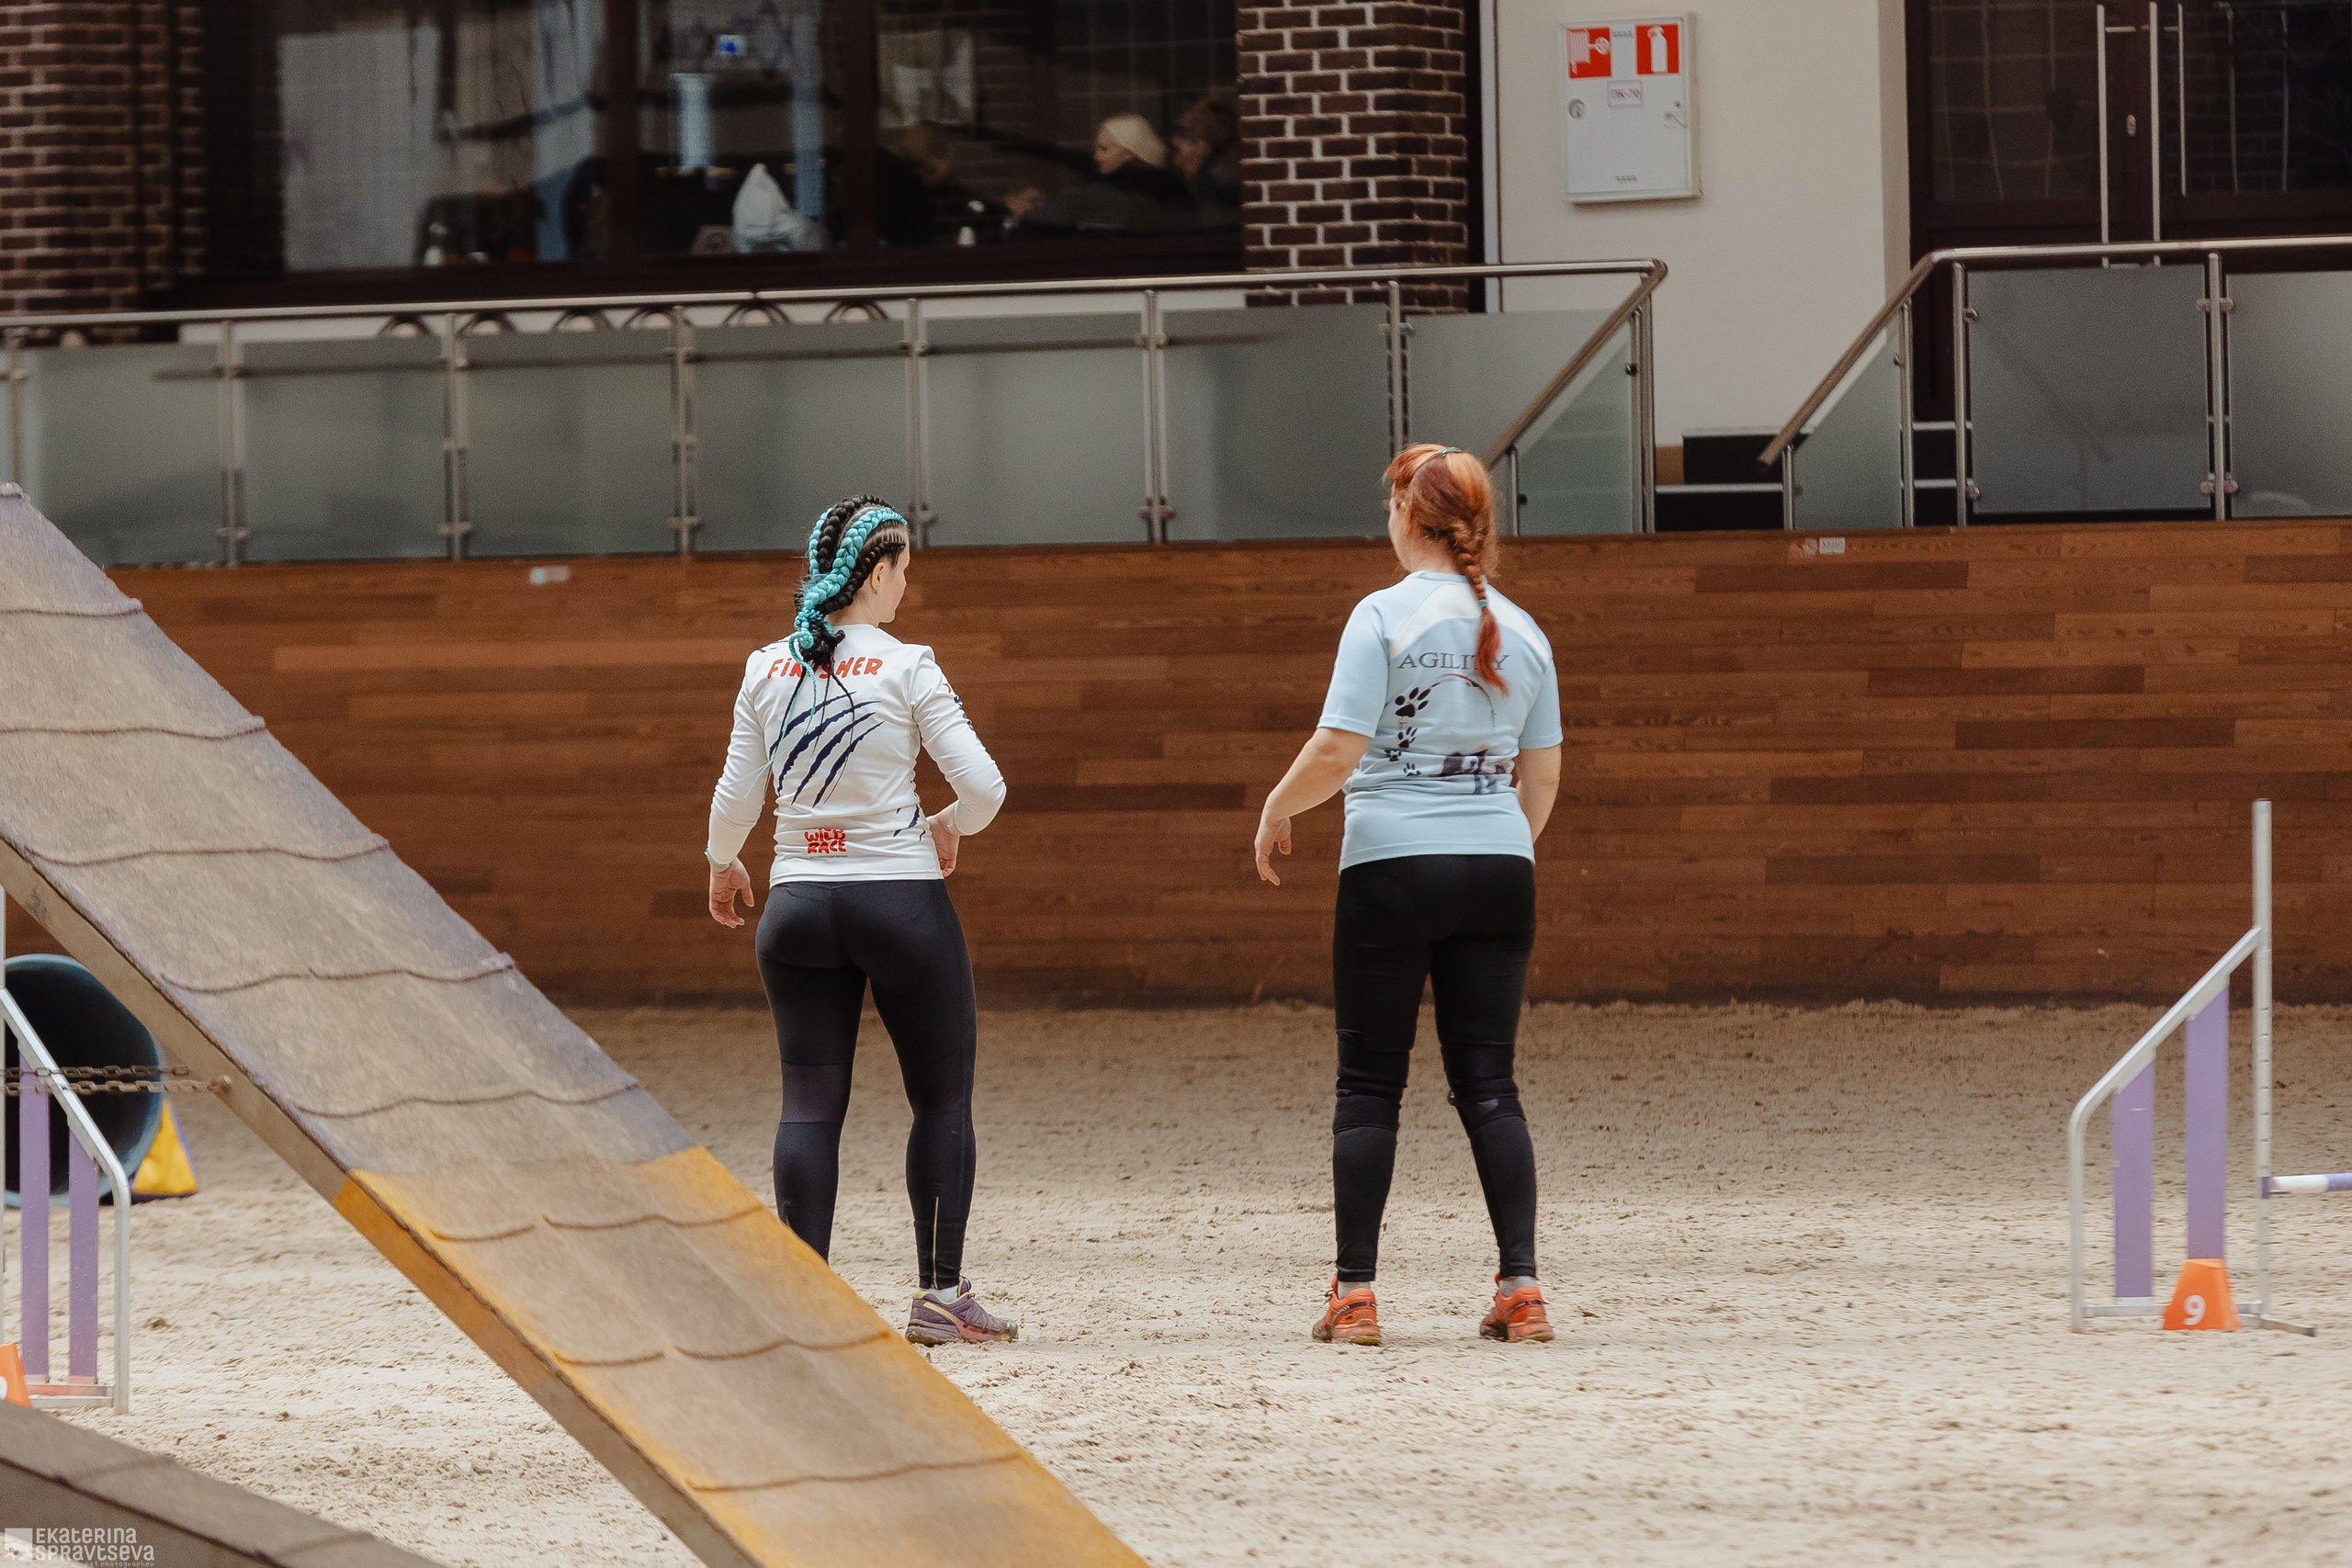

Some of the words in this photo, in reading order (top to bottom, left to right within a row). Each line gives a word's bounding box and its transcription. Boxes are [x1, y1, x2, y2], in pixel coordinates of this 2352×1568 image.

[1397, 651, 1510, 670] AGILIY
[808, 840, 846, 854] RACE
[2183, 1294, 2207, 1325] 9
